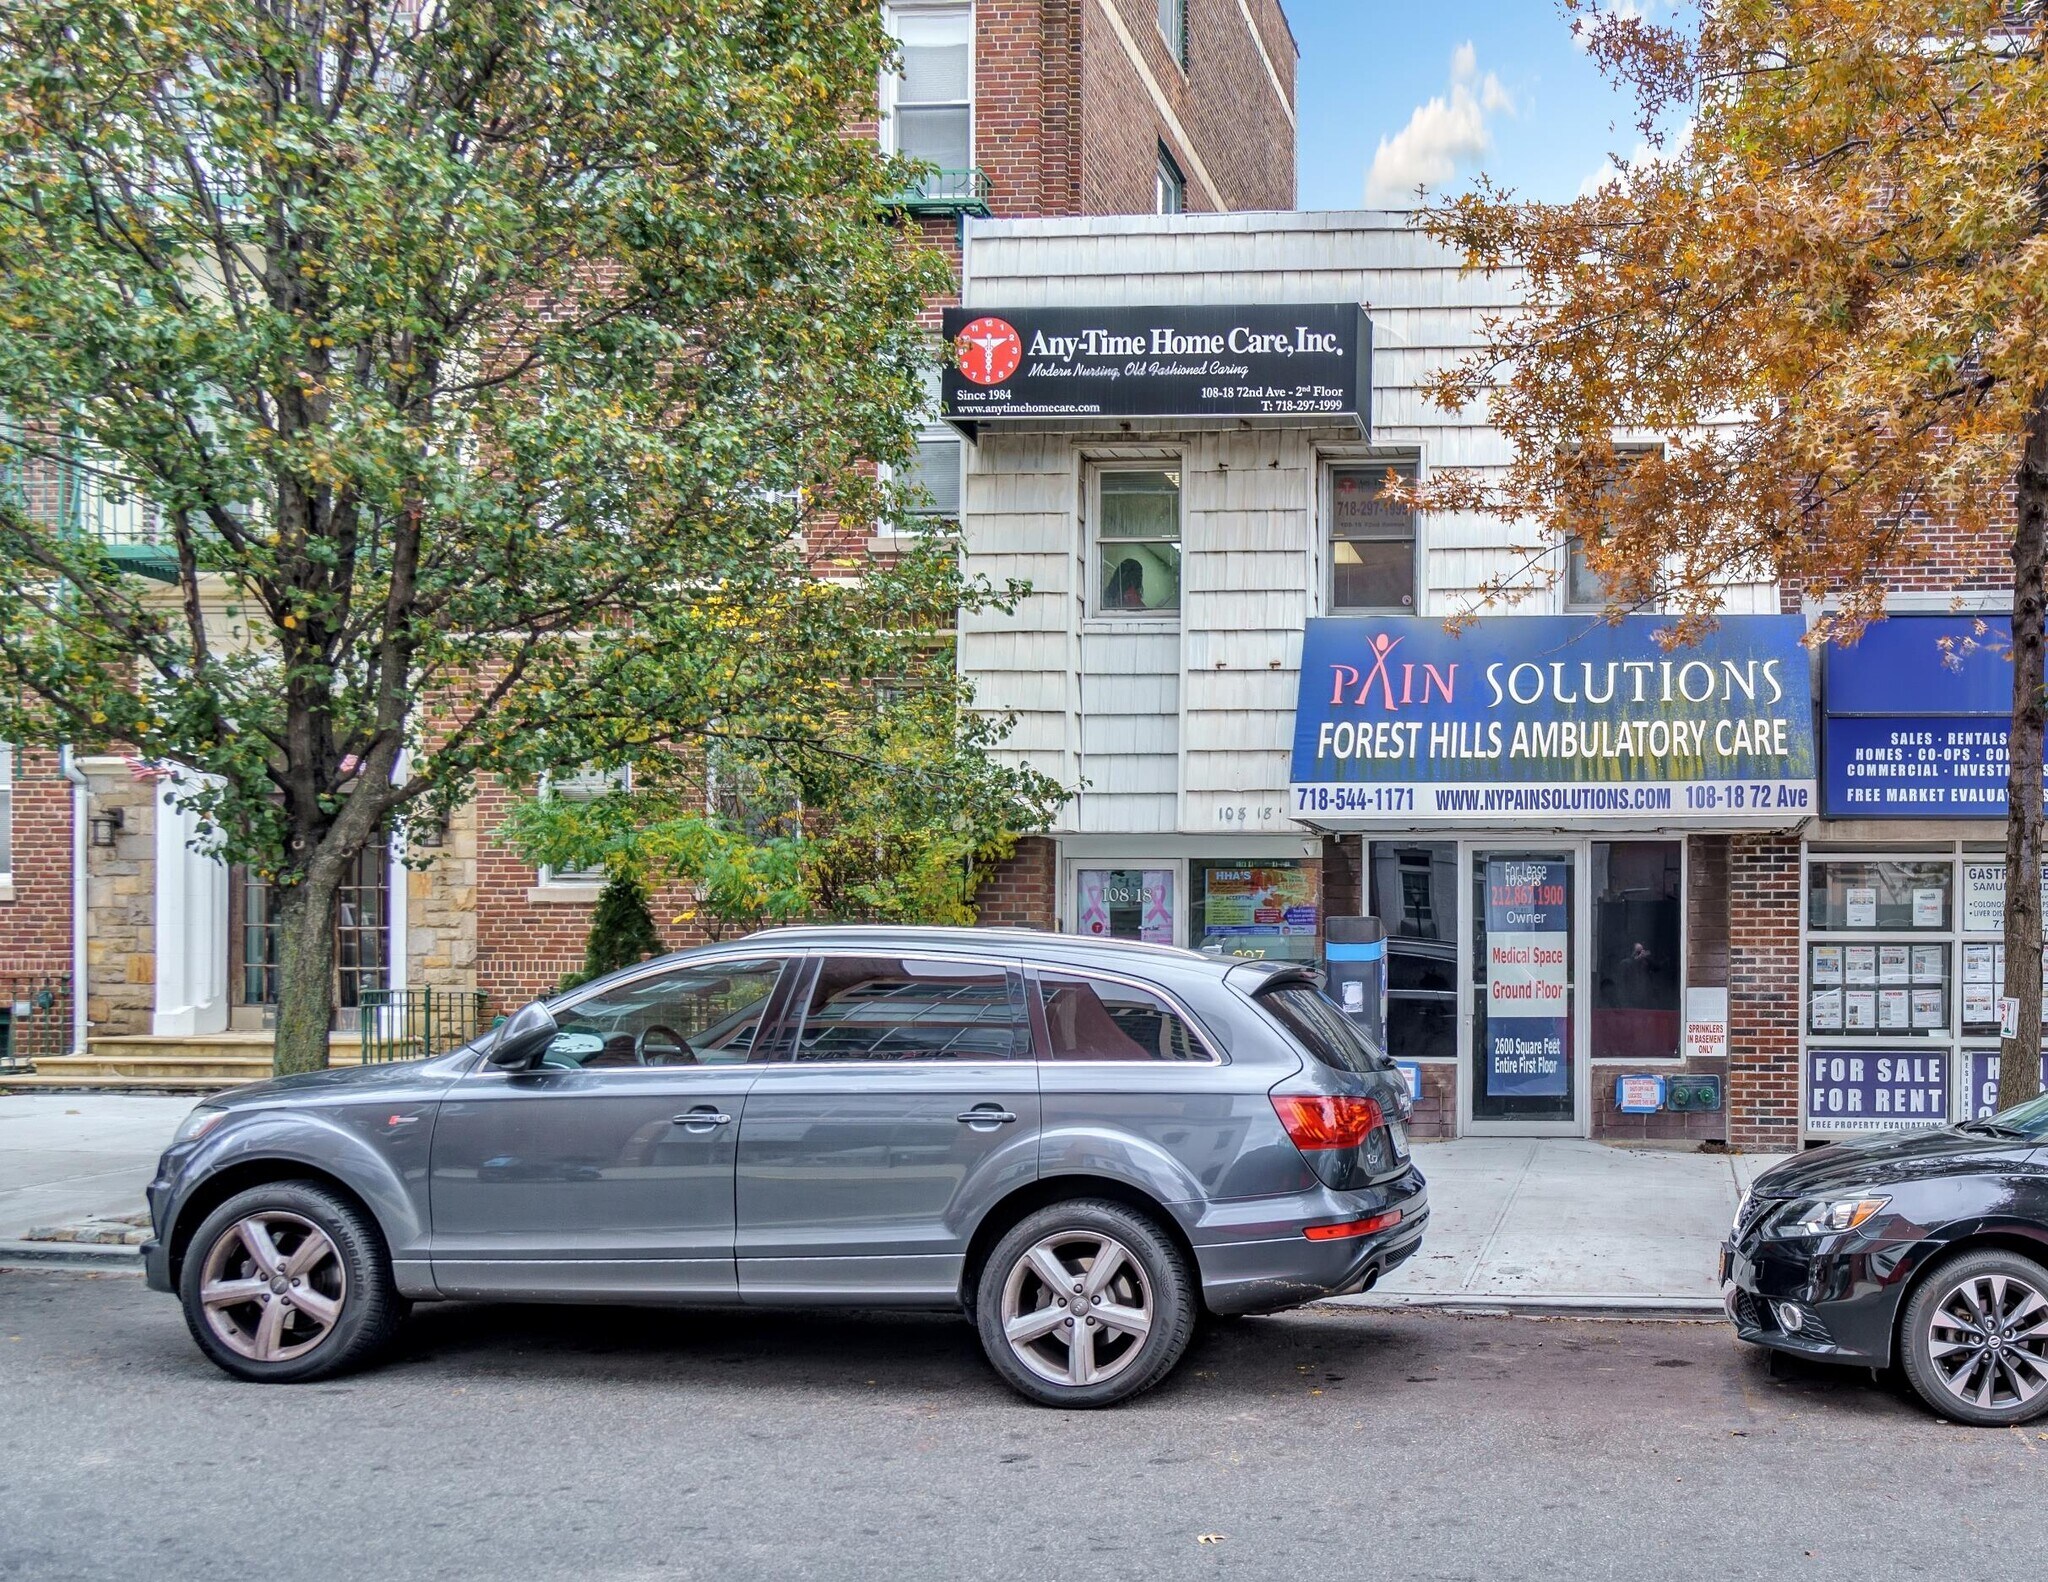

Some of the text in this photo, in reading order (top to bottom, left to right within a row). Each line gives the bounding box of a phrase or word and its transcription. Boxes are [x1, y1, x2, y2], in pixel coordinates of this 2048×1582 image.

[1028, 329, 1146, 362] Any-Time
[1150, 329, 1224, 354] Home
[1028, 360, 1249, 381] Modern Nursing, Old Fashioned Caring
[957, 389, 1012, 400] Since 1984
[1201, 387, 1234, 398] 108-18
[1237, 386, 1263, 397] 72nd
[1265, 387, 1286, 397] Ave
[1313, 385, 1343, 397] Floor
[957, 403, 1101, 415] www.anytimehomecare.com
[1276, 400, 1343, 411] 718-297-1999
[1329, 636, 1782, 711] PAIN SOLUTIONS
[1318, 718, 1788, 759] FOREST HILLS AMBULATORY CARE
[1891, 732, 2007, 745] SALES RENTALS
[1855, 748, 1903, 761] HOMES
[1918, 748, 1970, 761] CO-OPS
[1847, 764, 1939, 777] COMMERCIAL
[1297, 784, 1807, 811] 718-544-1171 WWW.NYPAINSOLUTIONS.COM 108-18 72 Ave
[1847, 788, 1881, 802] FREE
[1886, 788, 1945, 802] MARKET
[1219, 806, 1247, 821] 108
[1505, 861, 1547, 881] For Lease
[1506, 911, 1547, 924] Owner
[1493, 947, 1563, 967] Medical Space
[1493, 980, 1563, 999] Ground Floor
[1688, 1024, 1724, 1033] SPRINKLERS
[1687, 1035, 1725, 1043] IN BASEMENT
[1495, 1038, 1561, 1059] 2600 Square Feet
[1698, 1045, 1714, 1054] ONLY
[1495, 1057, 1558, 1074] Entire First Floor
[1815, 1058, 1940, 1082] FOR SALE
[1813, 1088, 1942, 1112] FOR RENT
[1811, 1120, 1831, 1128] FREE
[1835, 1121, 1880, 1129] PROPERTY
